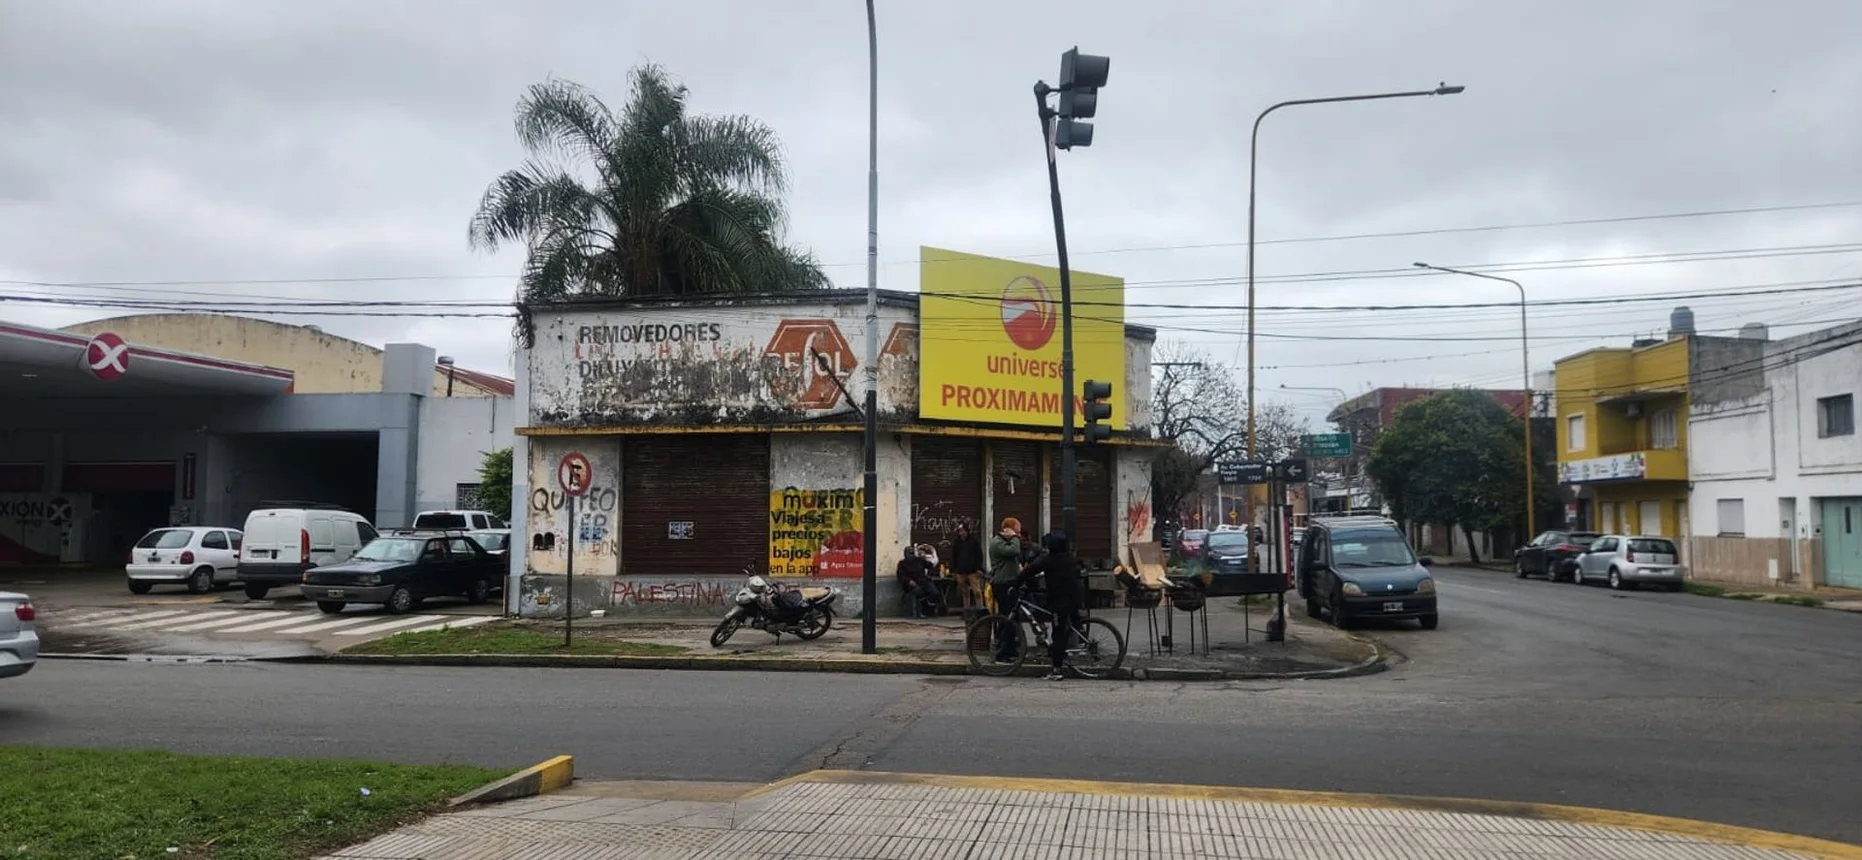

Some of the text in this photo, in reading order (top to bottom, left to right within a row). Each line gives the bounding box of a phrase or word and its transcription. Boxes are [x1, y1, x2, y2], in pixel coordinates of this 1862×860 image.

[579, 323, 721, 344] REMOVEDORES
[772, 525, 824, 542] precios
[773, 545, 812, 561] bajos
[611, 582, 727, 606] PALESTINA
